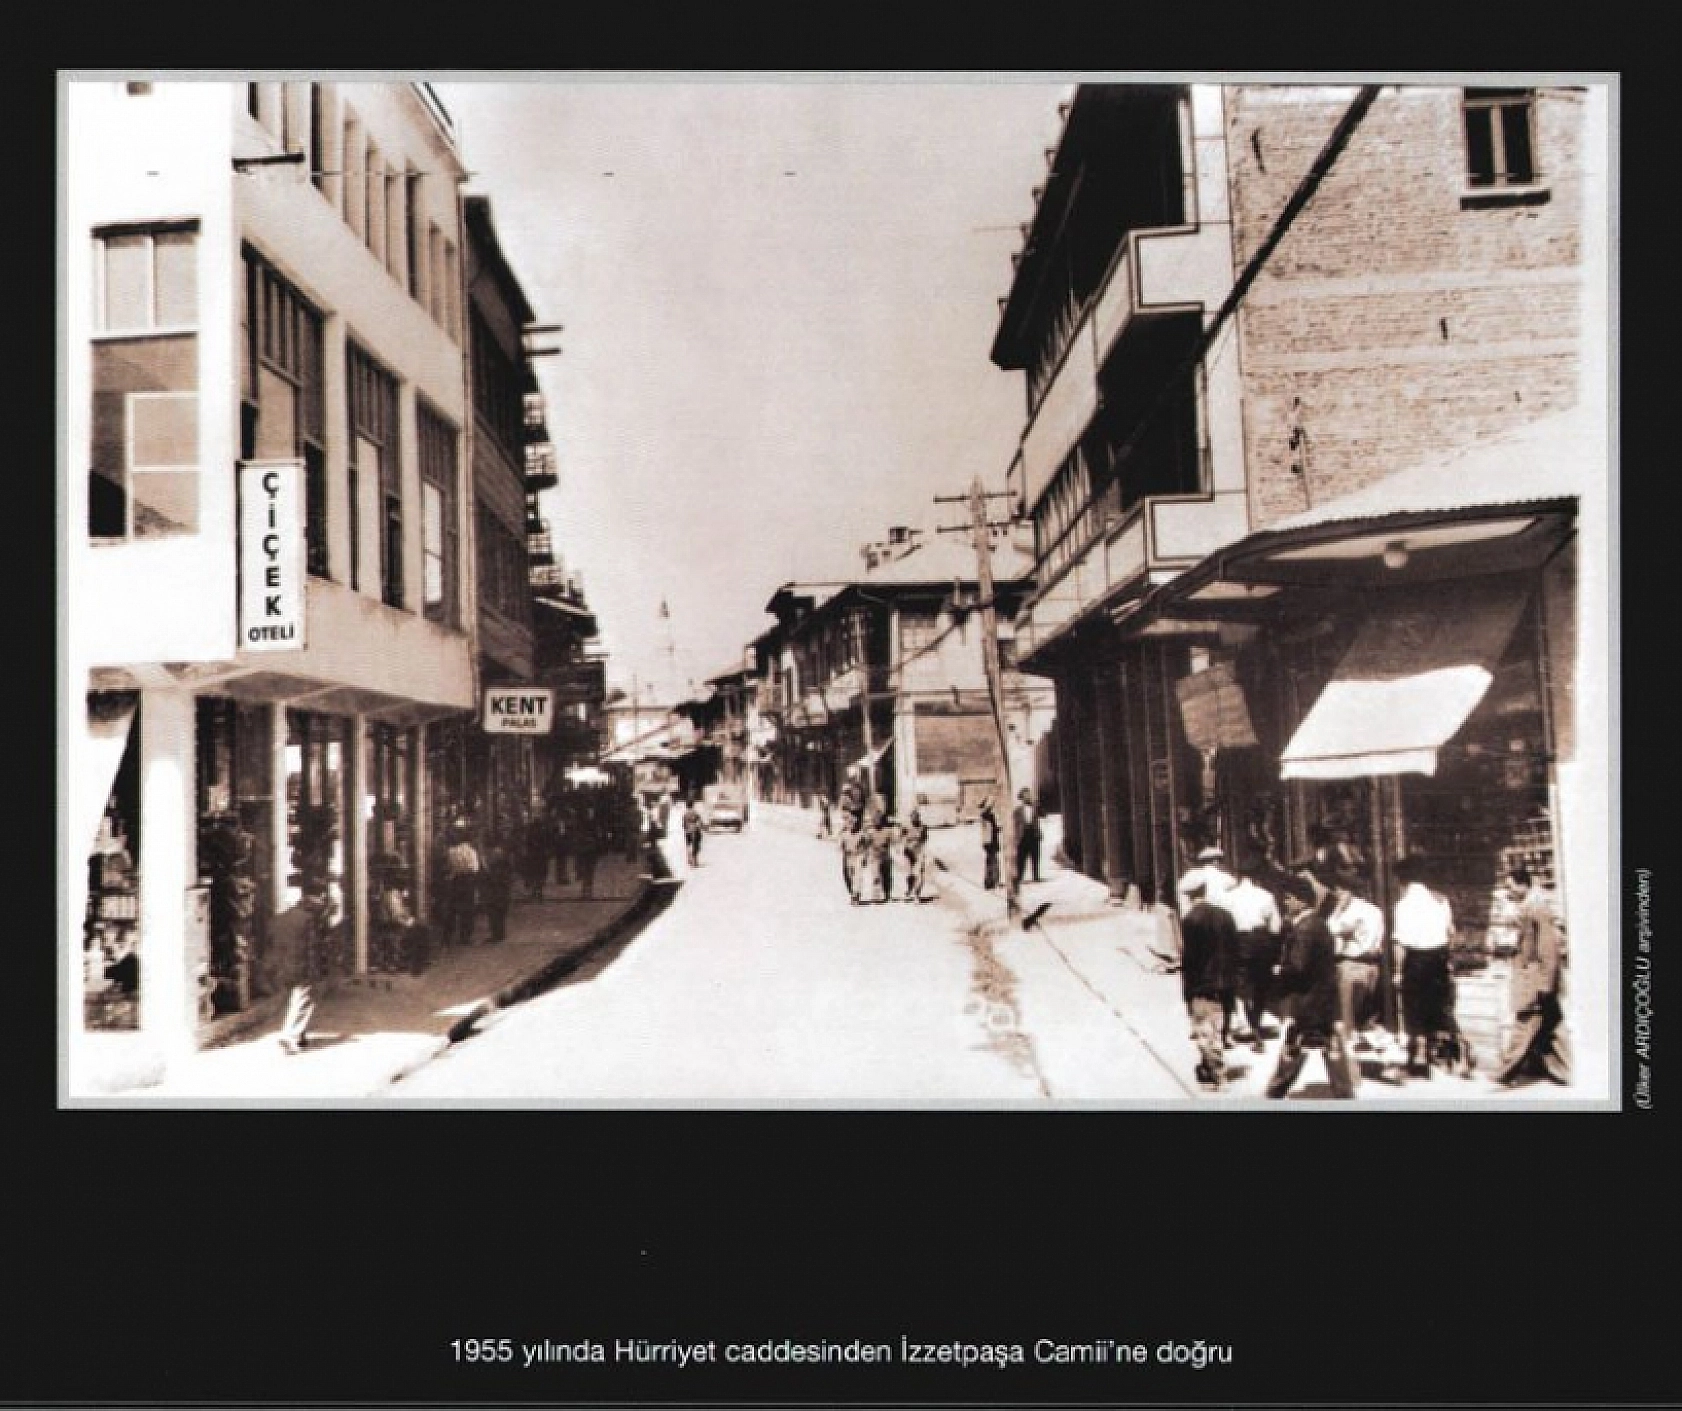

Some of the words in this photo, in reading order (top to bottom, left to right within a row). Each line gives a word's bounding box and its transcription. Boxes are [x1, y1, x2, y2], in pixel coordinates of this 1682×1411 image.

[262, 472, 282, 617] ÇİÇEK
[248, 623, 294, 642] OTELİ
[491, 696, 548, 715] KENT
